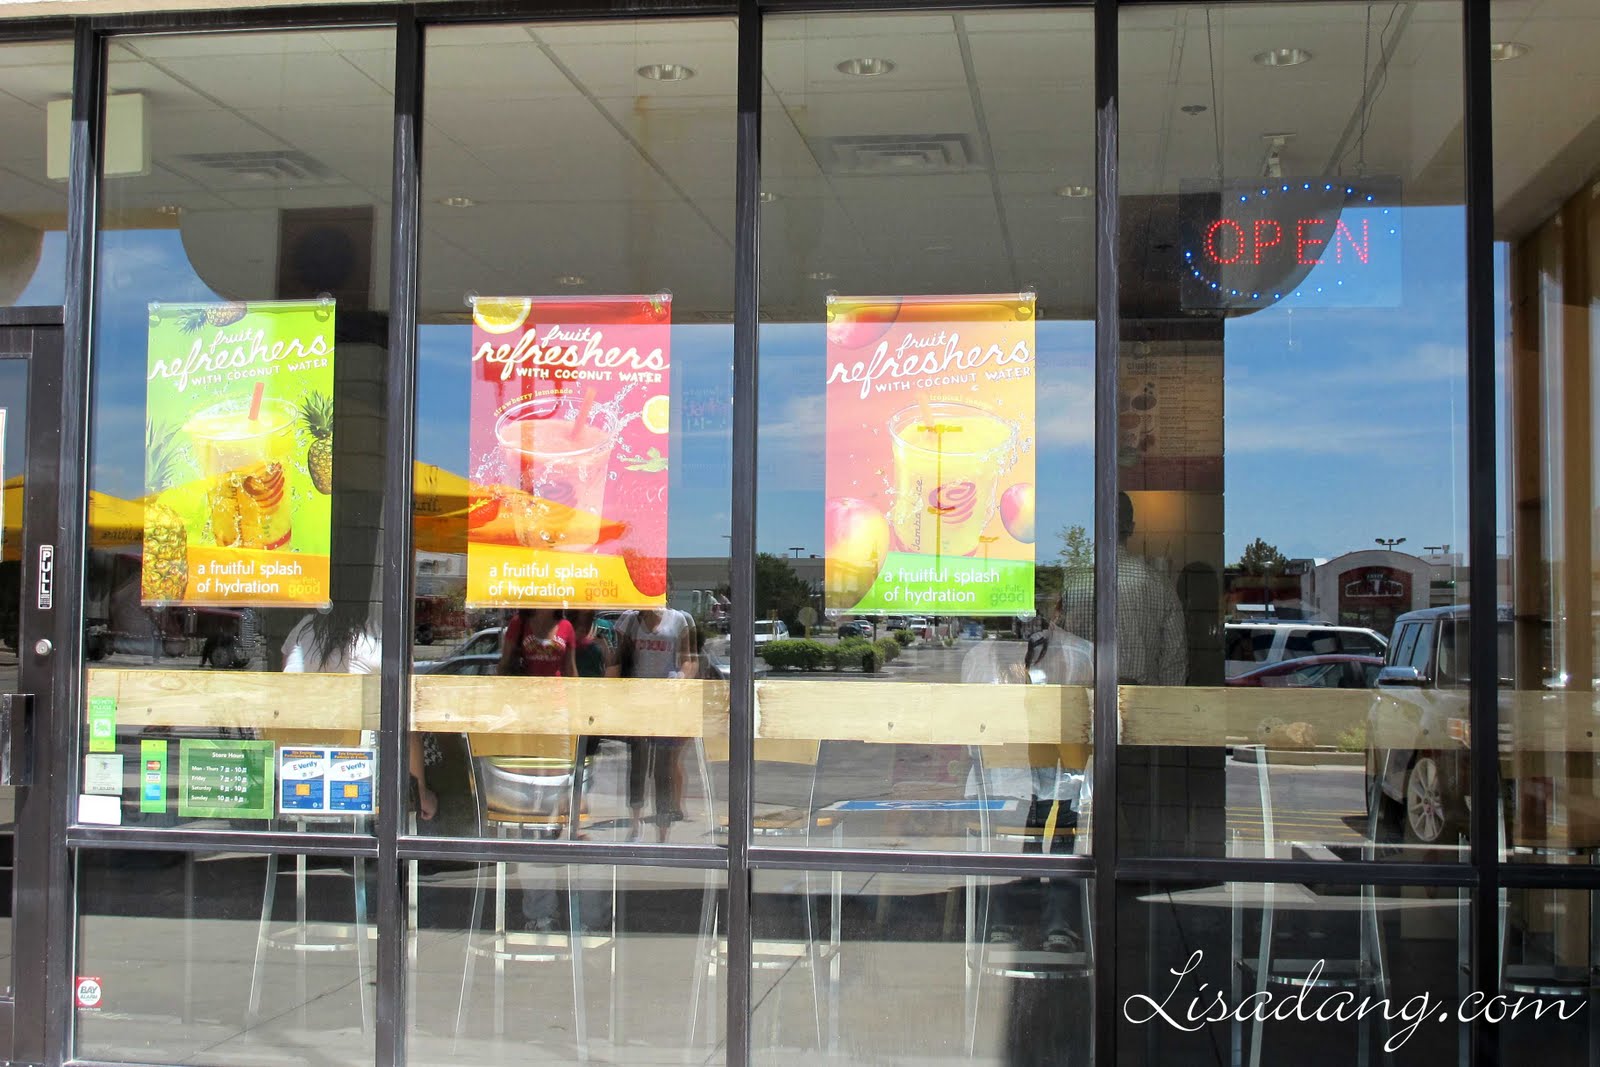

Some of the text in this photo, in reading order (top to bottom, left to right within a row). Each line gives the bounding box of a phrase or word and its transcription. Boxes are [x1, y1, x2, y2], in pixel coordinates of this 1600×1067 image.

[1204, 218, 1370, 265] OPEN
[209, 328, 255, 354] fruit
[541, 325, 592, 347] fruit
[895, 331, 947, 357] fruit
[147, 330, 335, 392] refreshers
[472, 328, 671, 380] refreshers
[191, 358, 328, 386] WITH COCONUT WATER
[827, 332, 1035, 399] refreshers
[516, 367, 662, 383] WITH COCONUT WATER
[875, 366, 1031, 393] WITH COCONUT WATER
[534, 388, 573, 397] lemonade
[41, 550, 51, 594] PULL
[197, 560, 302, 577] a fruitful splash
[489, 562, 598, 580] a fruitful splash
[884, 567, 1000, 585] a fruitful splash
[197, 579, 279, 596] of hydration
[288, 581, 321, 598] good
[488, 581, 575, 599] of hydration
[584, 584, 618, 602] good
[884, 587, 899, 602] of
[904, 587, 975, 604] hydration
[990, 589, 1025, 607] good
[80, 985, 98, 994] BAY
